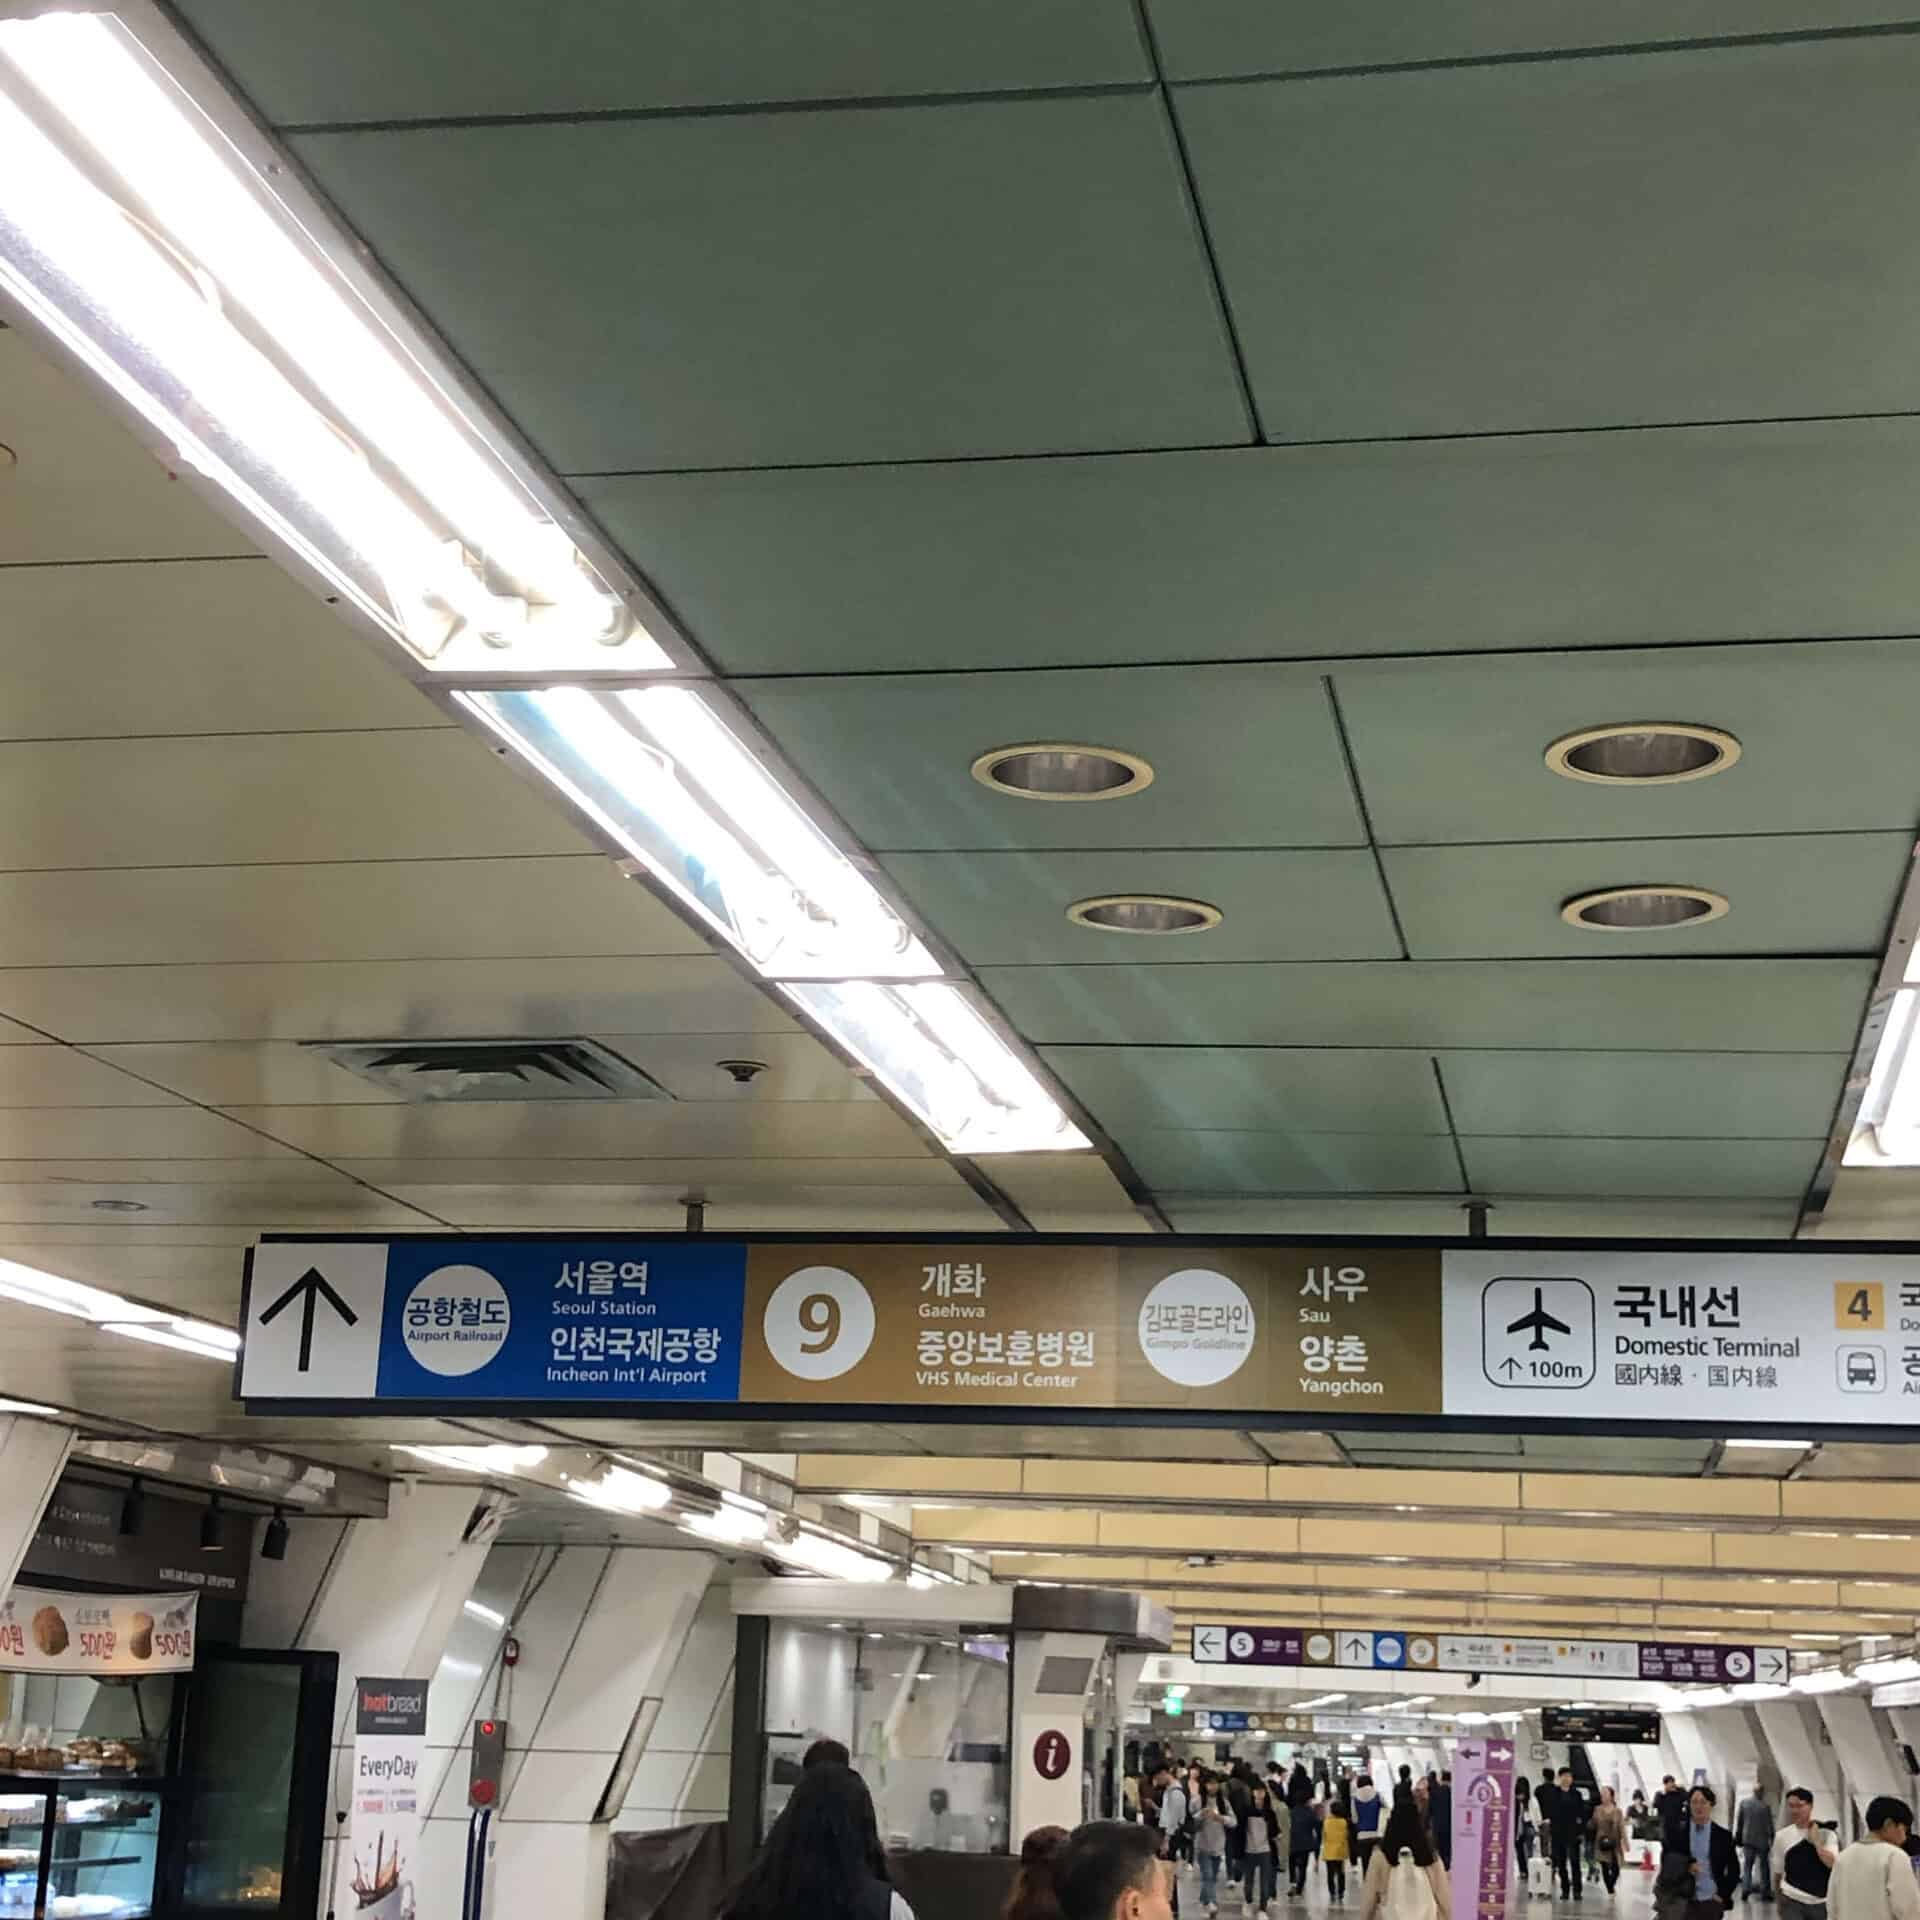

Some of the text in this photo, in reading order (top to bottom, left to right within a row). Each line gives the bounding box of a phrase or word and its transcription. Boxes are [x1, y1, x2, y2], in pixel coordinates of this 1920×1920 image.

[554, 1260, 649, 1296] 서울역
[920, 1263, 987, 1298] 개화
[1299, 1266, 1369, 1303] 사우
[407, 1298, 507, 1327] 공항철도
[552, 1301, 657, 1316] Seoul Station
[918, 1303, 986, 1318] Gaehwa
[1146, 1304, 1250, 1334] 김포골드라인
[1299, 1308, 1331, 1323] Sau
[1613, 1285, 1741, 1328] 국내선
[1847, 1289, 1872, 1322] 4
[407, 1328, 503, 1344] Airport Railroad
[798, 1293, 841, 1354] 9
[550, 1327, 722, 1364] 인천국제공항
[917, 1330, 1095, 1367] 중앙보훈병원
[1300, 1335, 1369, 1373] 양촌
[1615, 1335, 1800, 1358] Domestic Terminal
[546, 1367, 707, 1385] Incheon Int'l Airport
[916, 1371, 1079, 1388] VHS Medical Center
[1529, 1361, 1583, 1379] 100m
[1299, 1378, 1383, 1397] Yangchon
[360, 1755, 417, 1780] EveryDay
